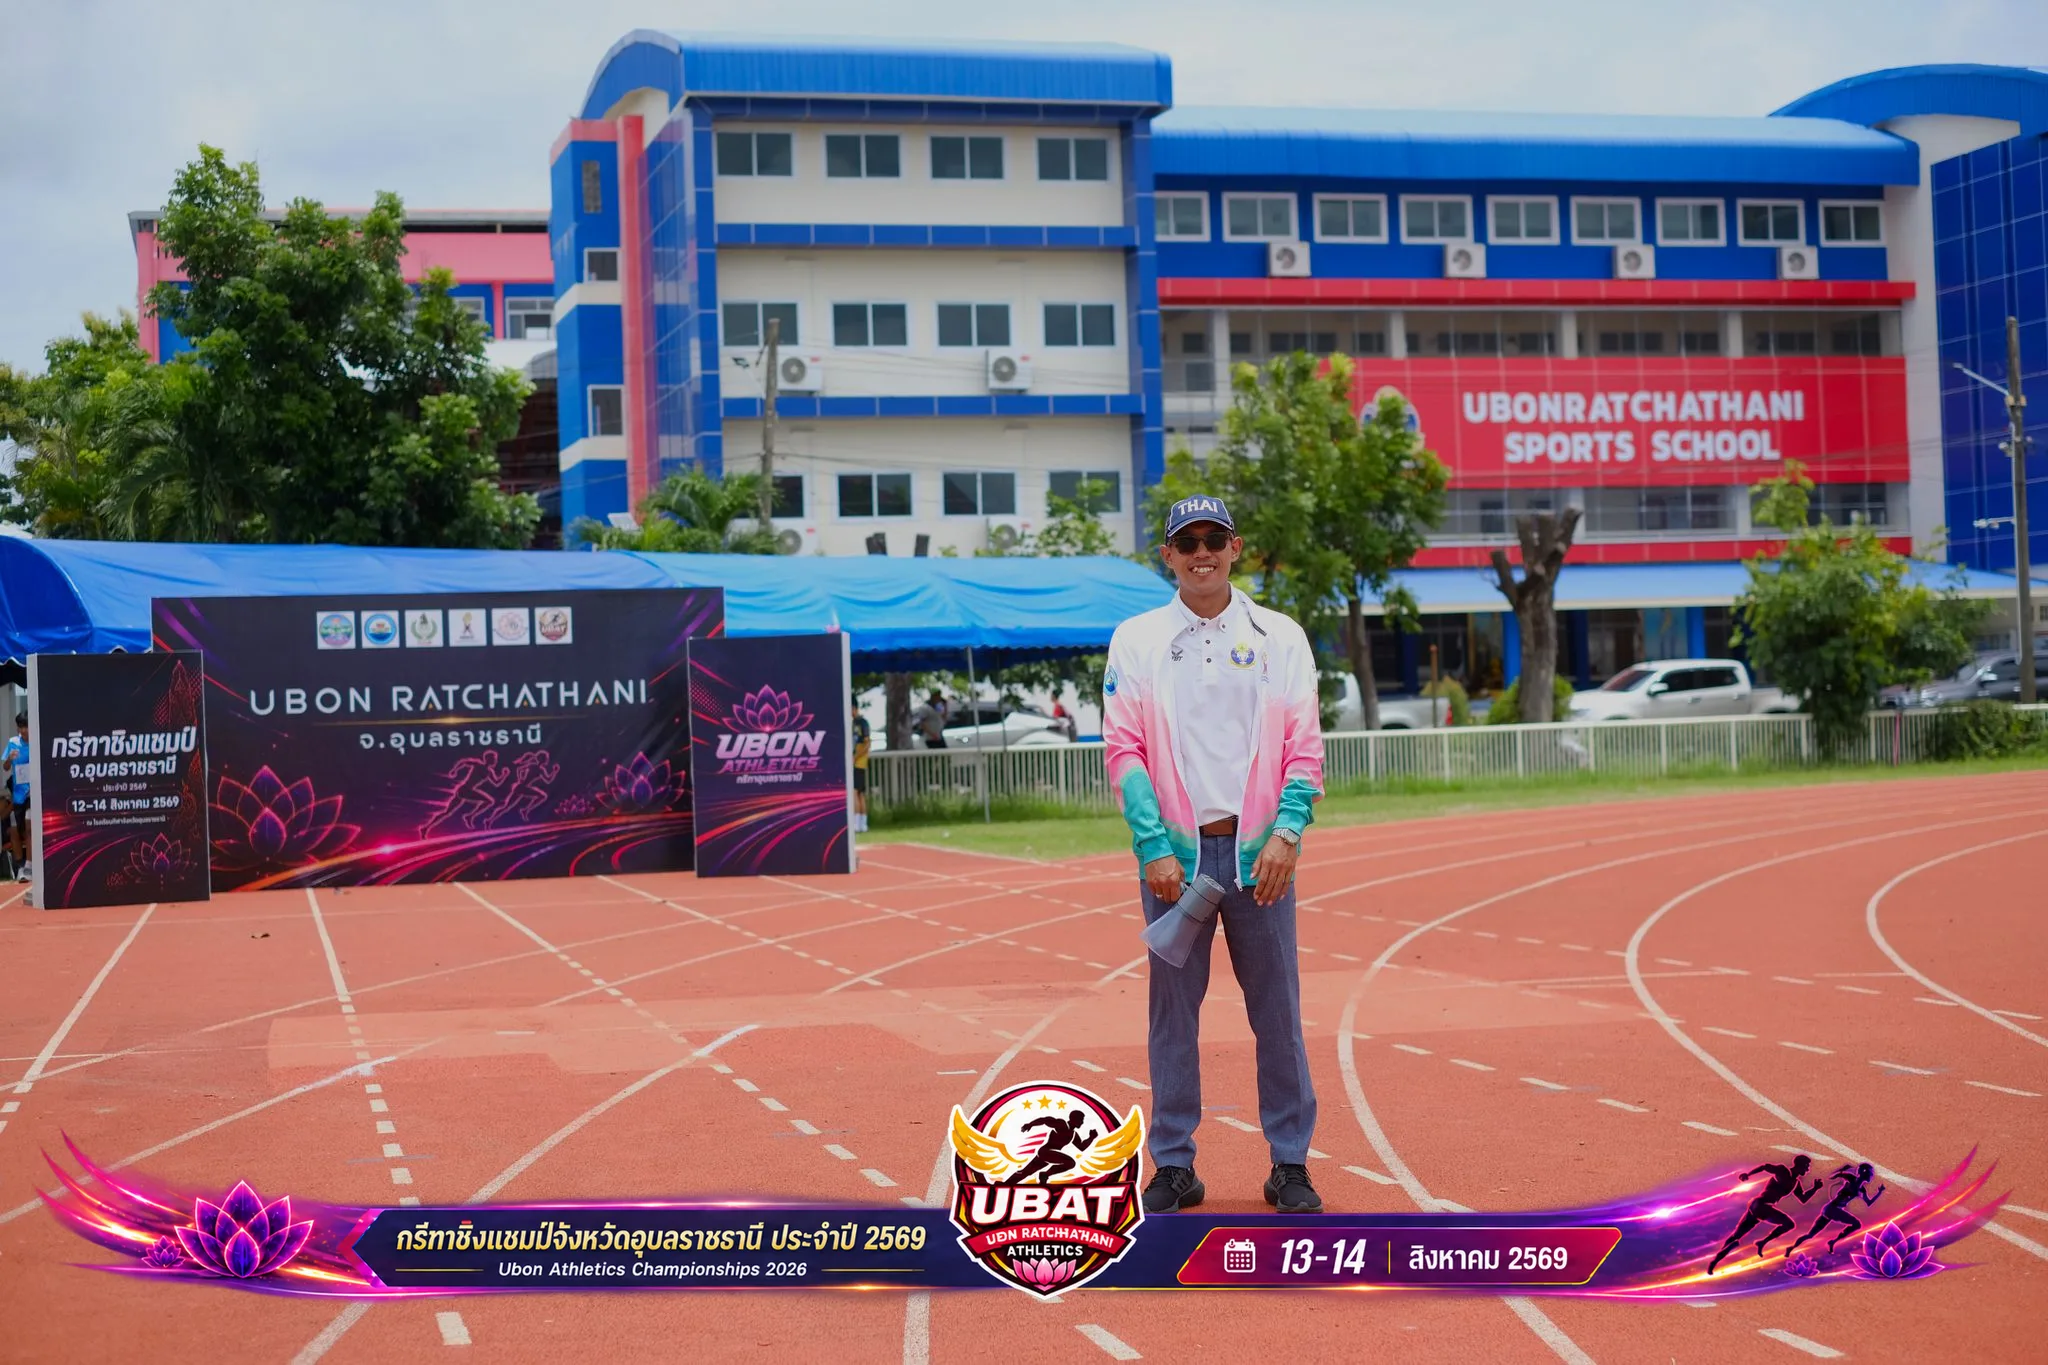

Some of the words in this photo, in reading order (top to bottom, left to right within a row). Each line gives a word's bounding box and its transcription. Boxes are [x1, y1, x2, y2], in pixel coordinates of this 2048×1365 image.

[1463, 390, 1804, 424] UBONRATCHATHANI
[1504, 431, 1635, 463] SPORTS
[1651, 430, 1780, 461] SCHOOL
[1178, 499, 1218, 516] THAI
[250, 686, 371, 716] UBON
[392, 679, 646, 712] RATCHATHANI
[359, 722, 541, 755] จ.อุบลราชธานี
[716, 730, 826, 759] UBON
[720, 757, 821, 773] ATHLETICS
[152, 795, 180, 809] 2569
